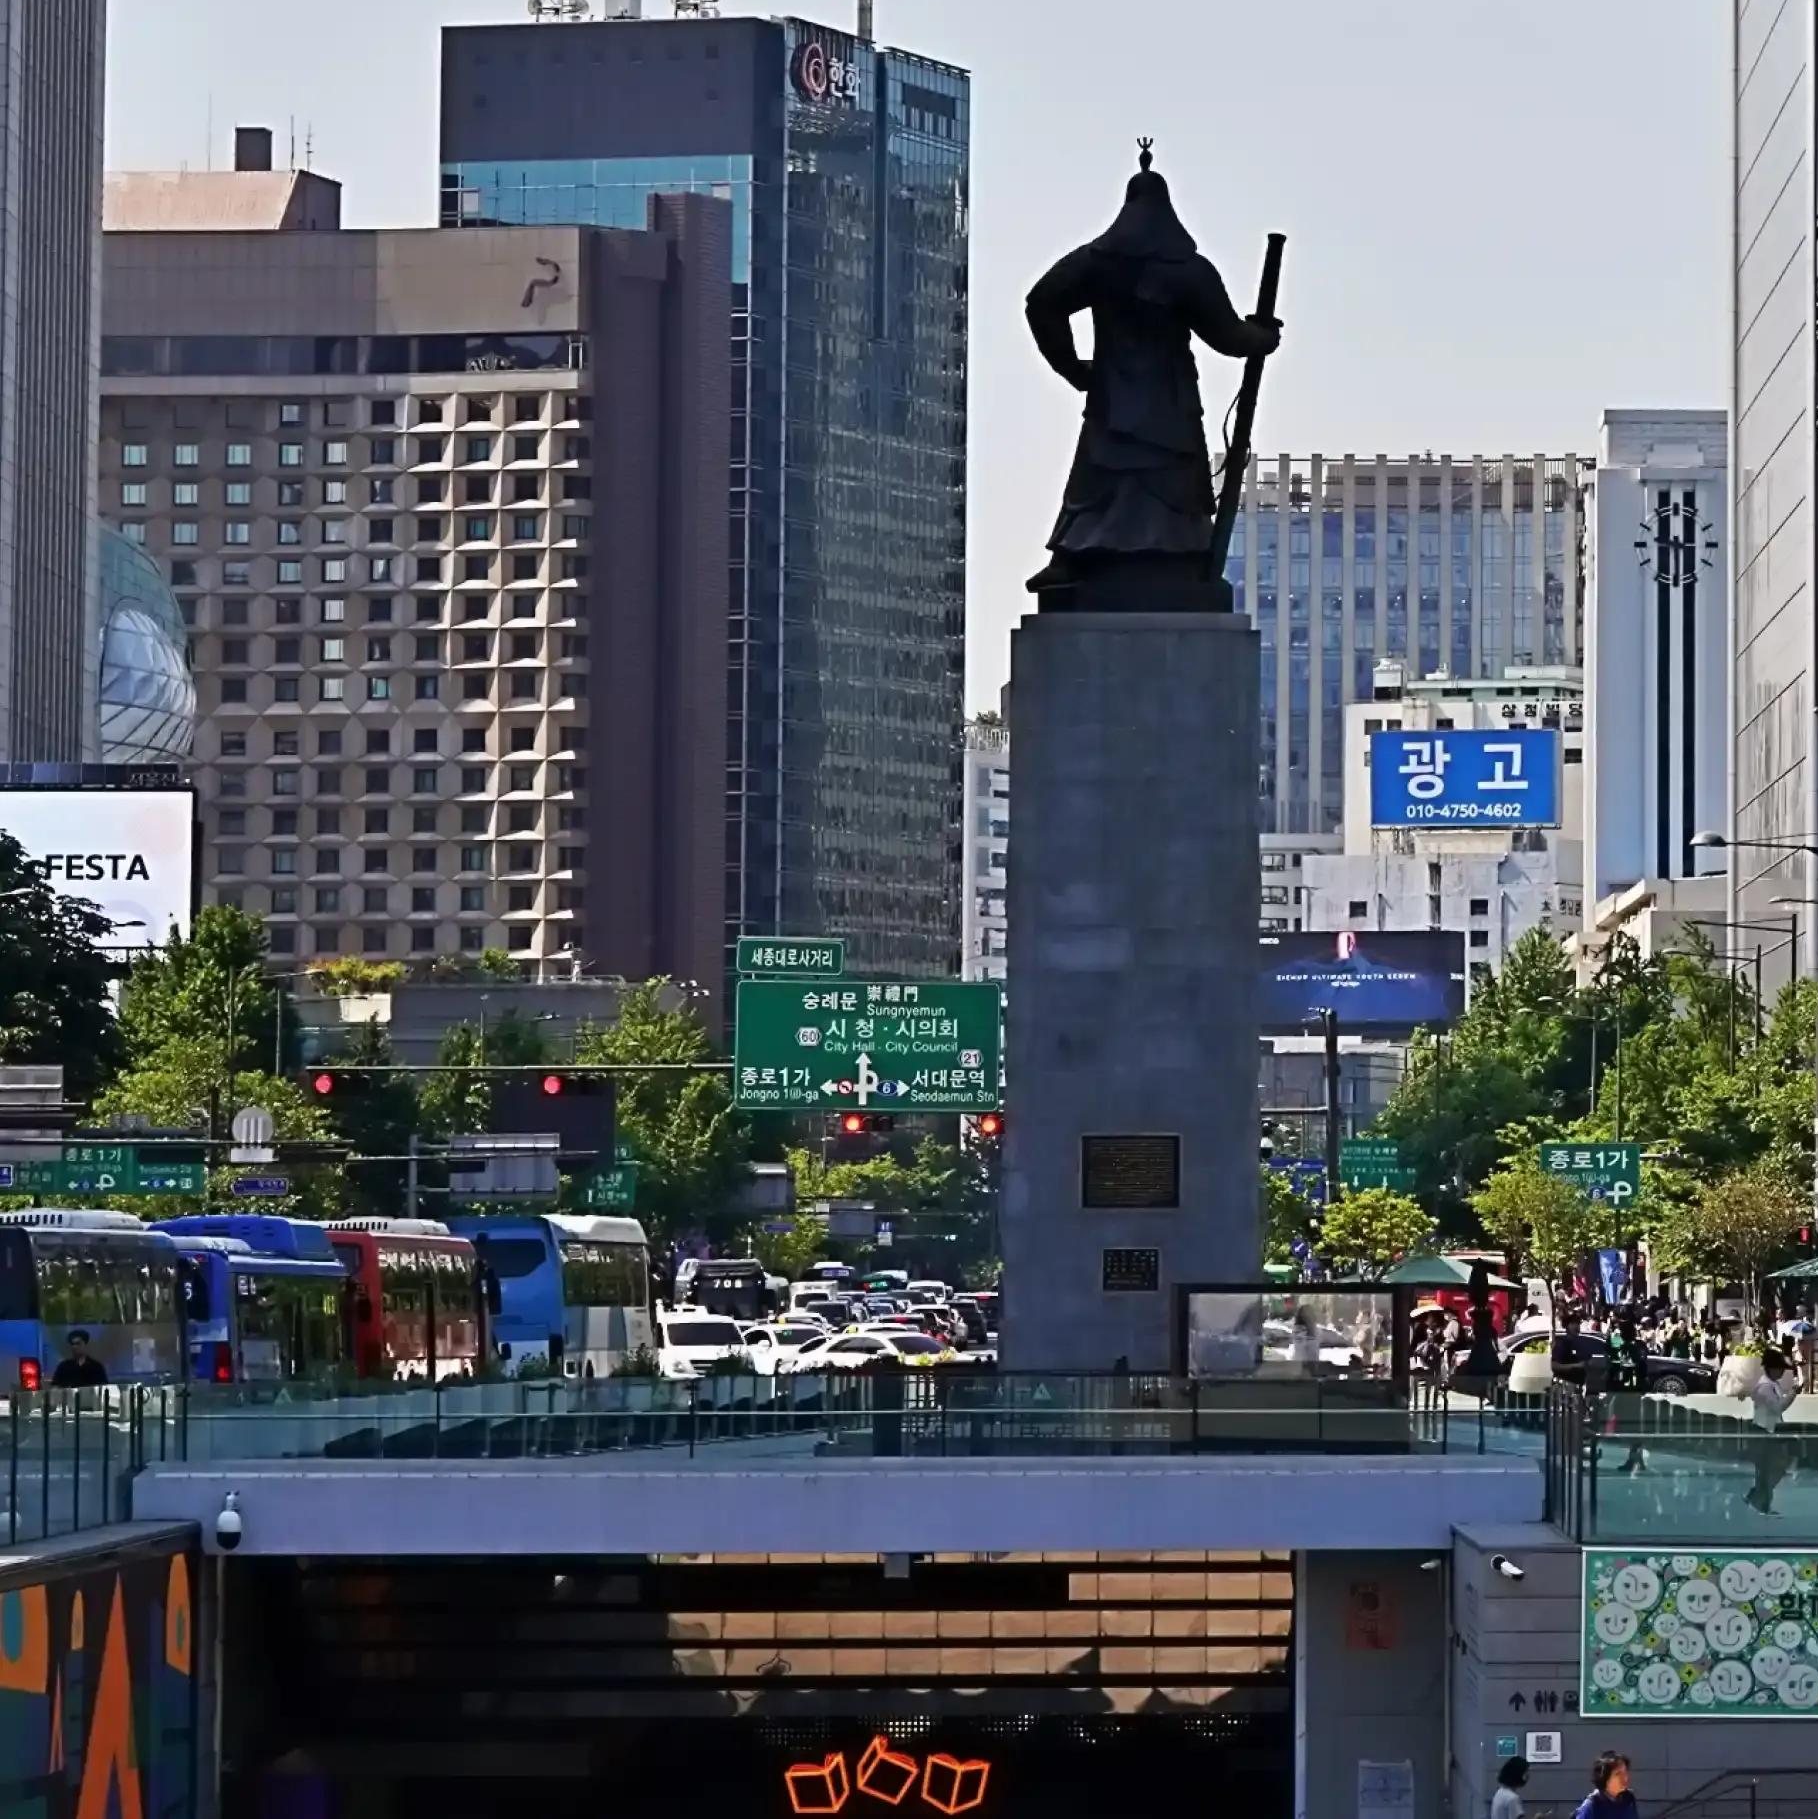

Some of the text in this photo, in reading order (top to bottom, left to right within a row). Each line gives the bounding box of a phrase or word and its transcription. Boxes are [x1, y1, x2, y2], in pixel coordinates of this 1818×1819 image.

[1406, 803, 1521, 818] 010-4750-4602
[45, 854, 150, 881] FESTA
[751, 947, 833, 968] 세종대로사거리
[802, 992, 858, 1011] 숭례문
[867, 985, 919, 1003] 崇禮門
[866, 1005, 946, 1019] Sungnyemun
[801, 1031, 818, 1043] 60
[895, 1019, 959, 1039] 시의회
[825, 1040, 958, 1053] City Hall City Council
[963, 1053, 979, 1064] 21
[740, 1067, 811, 1087] 종로1가
[914, 1069, 986, 1089] 서대문역
[740, 1089, 780, 1102] Jongno
[882, 1082, 891, 1093] 6
[911, 1090, 995, 1102] Seodaemun Stn
[1548, 1150, 1630, 1169] 종로1가
